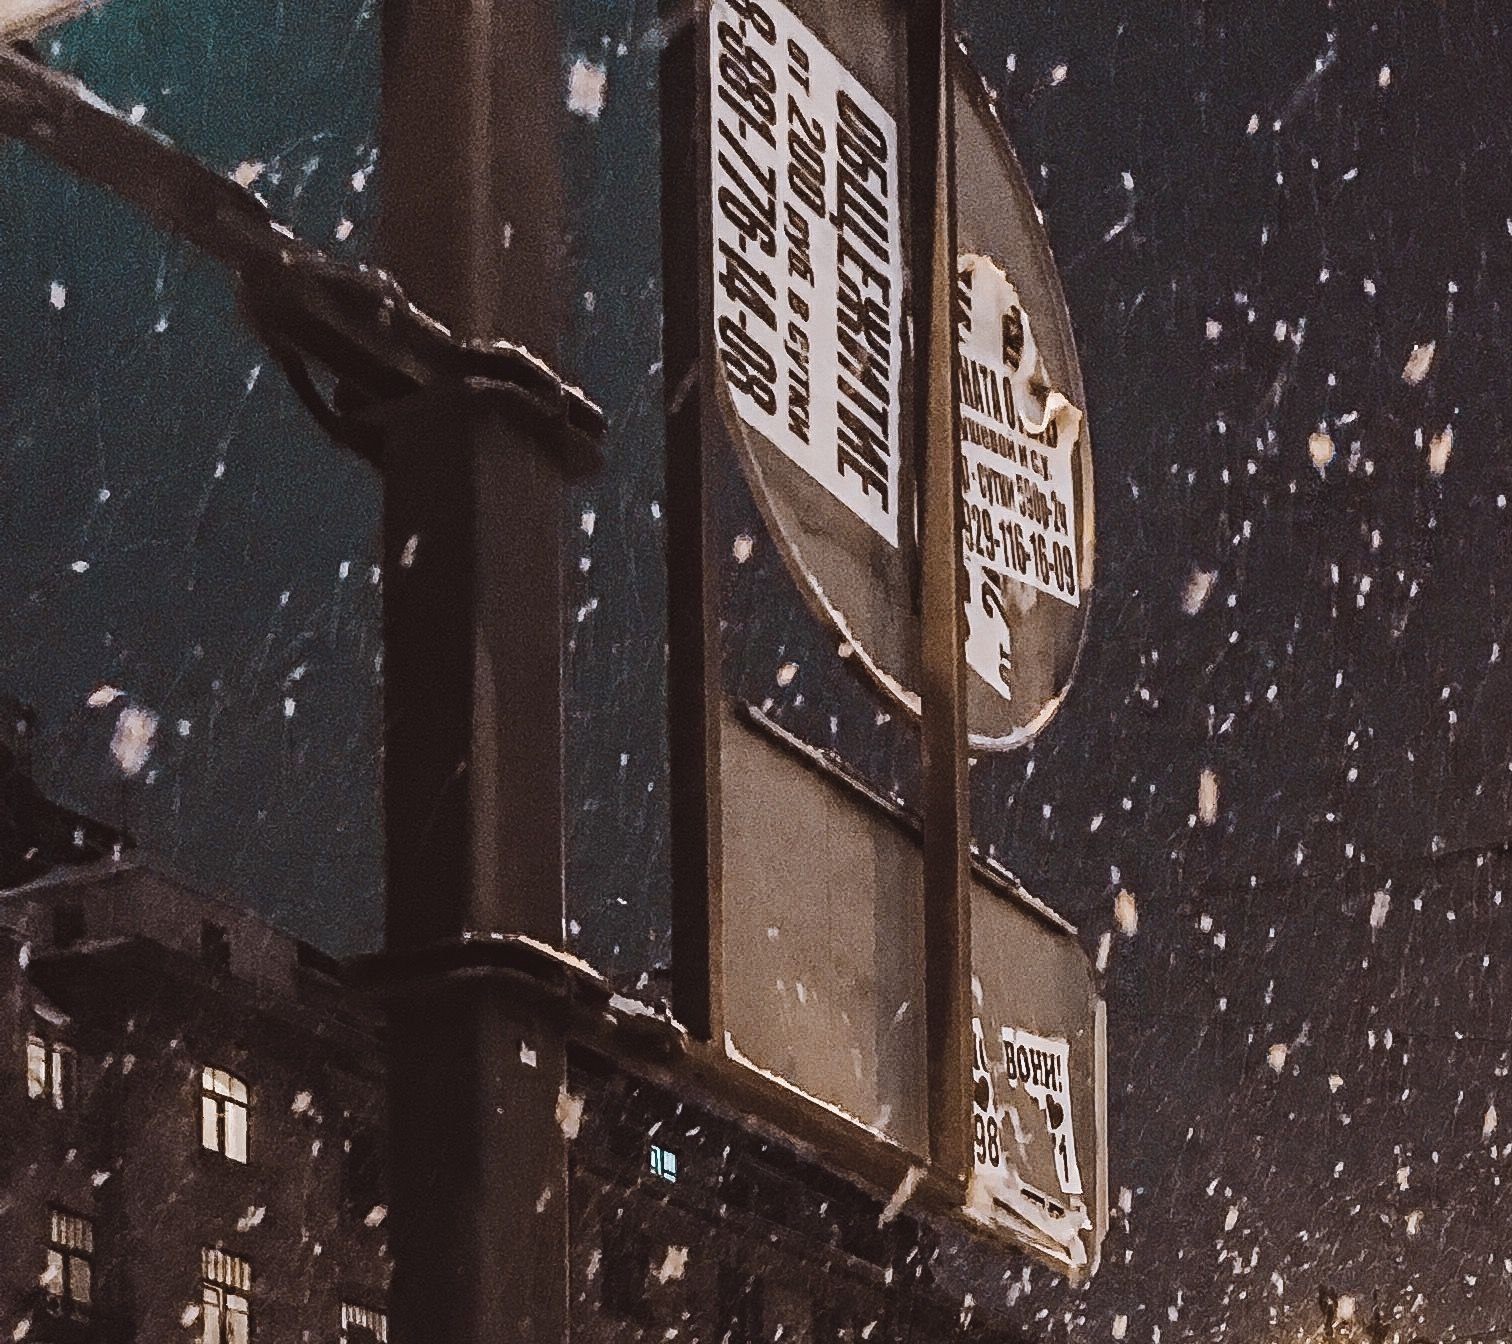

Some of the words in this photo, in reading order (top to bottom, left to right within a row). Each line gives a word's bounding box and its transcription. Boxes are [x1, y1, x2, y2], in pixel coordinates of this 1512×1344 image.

[787, 38, 810, 97] от
[787, 93, 826, 219] 200
[830, 89, 890, 514] ОБЩЕЖИТИЕ
[784, 320, 810, 445] сутки
